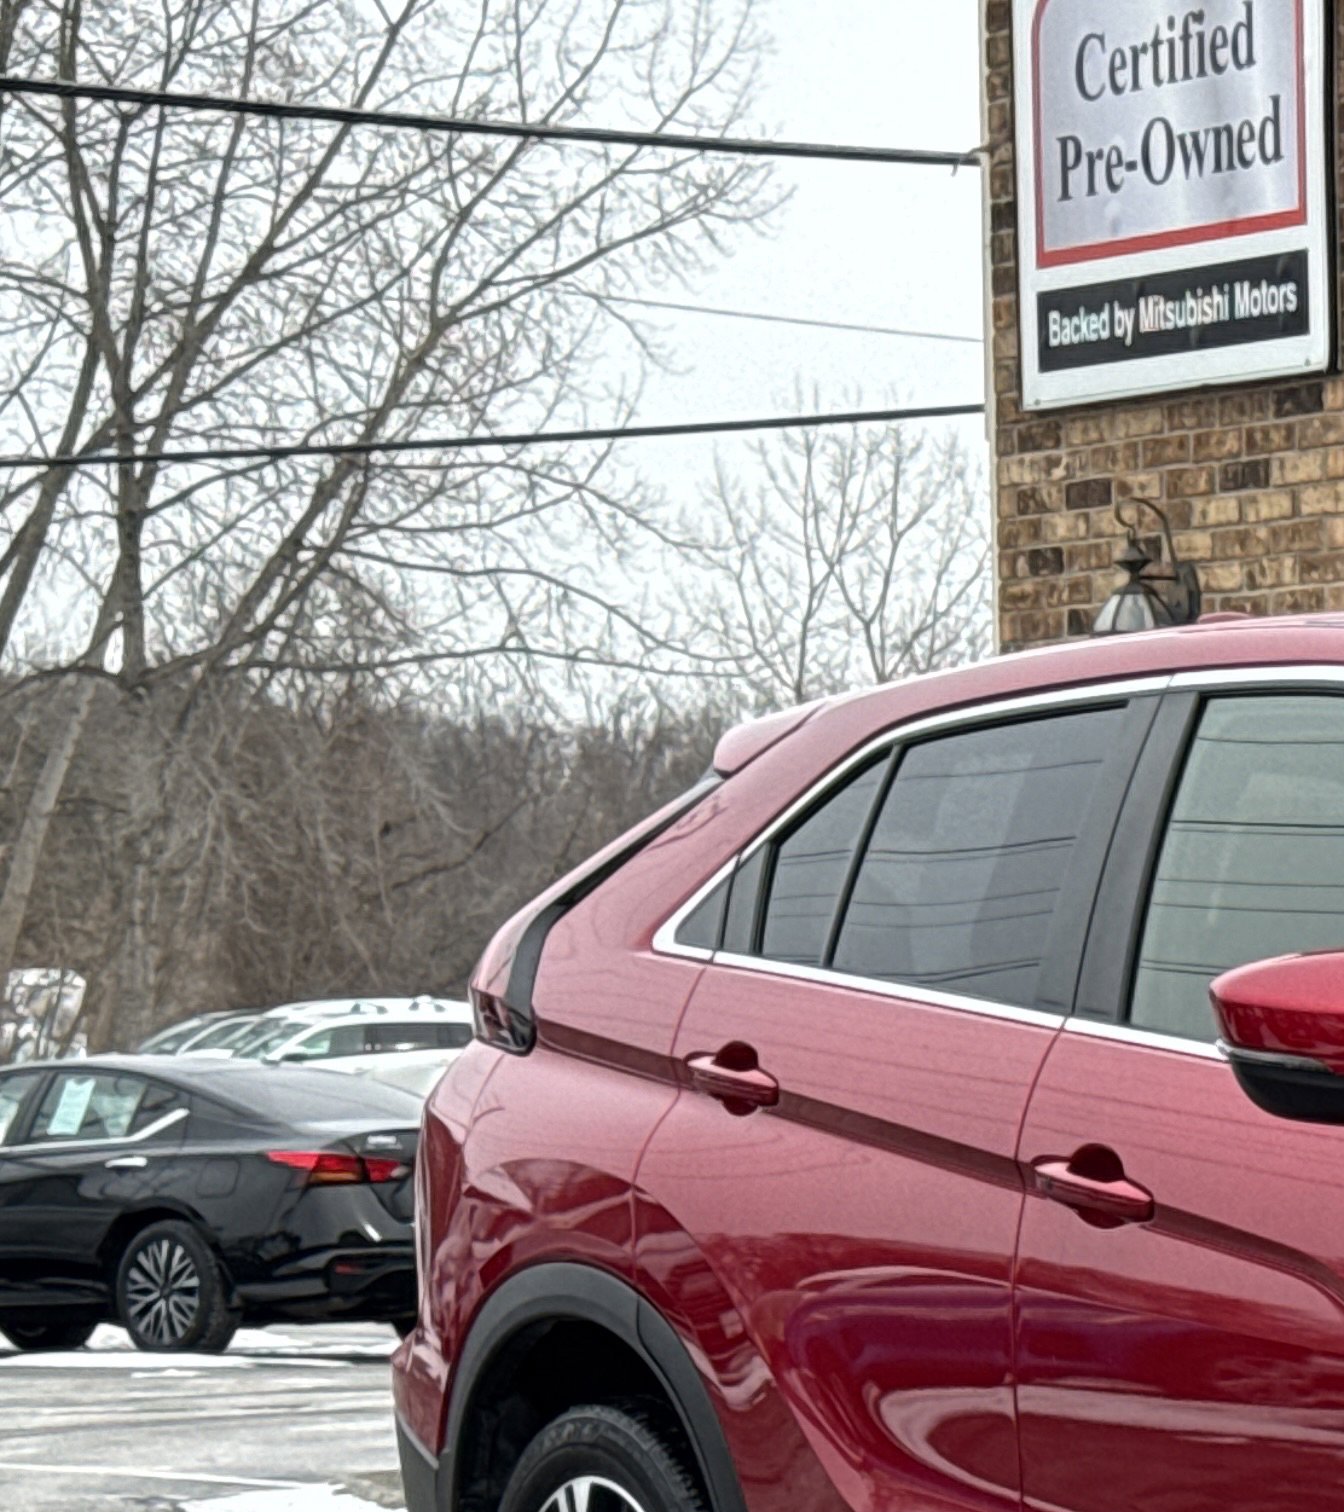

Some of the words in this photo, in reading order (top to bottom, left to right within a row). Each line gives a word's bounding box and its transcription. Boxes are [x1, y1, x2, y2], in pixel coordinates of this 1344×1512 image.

[1074, 0, 1257, 102] Certified
[1056, 94, 1285, 202] Pre-Owned
[1047, 302, 1111, 348] Backed
[1113, 300, 1136, 348] by
[1138, 283, 1231, 333] Mitsubishi
[1233, 279, 1298, 323] Motors
